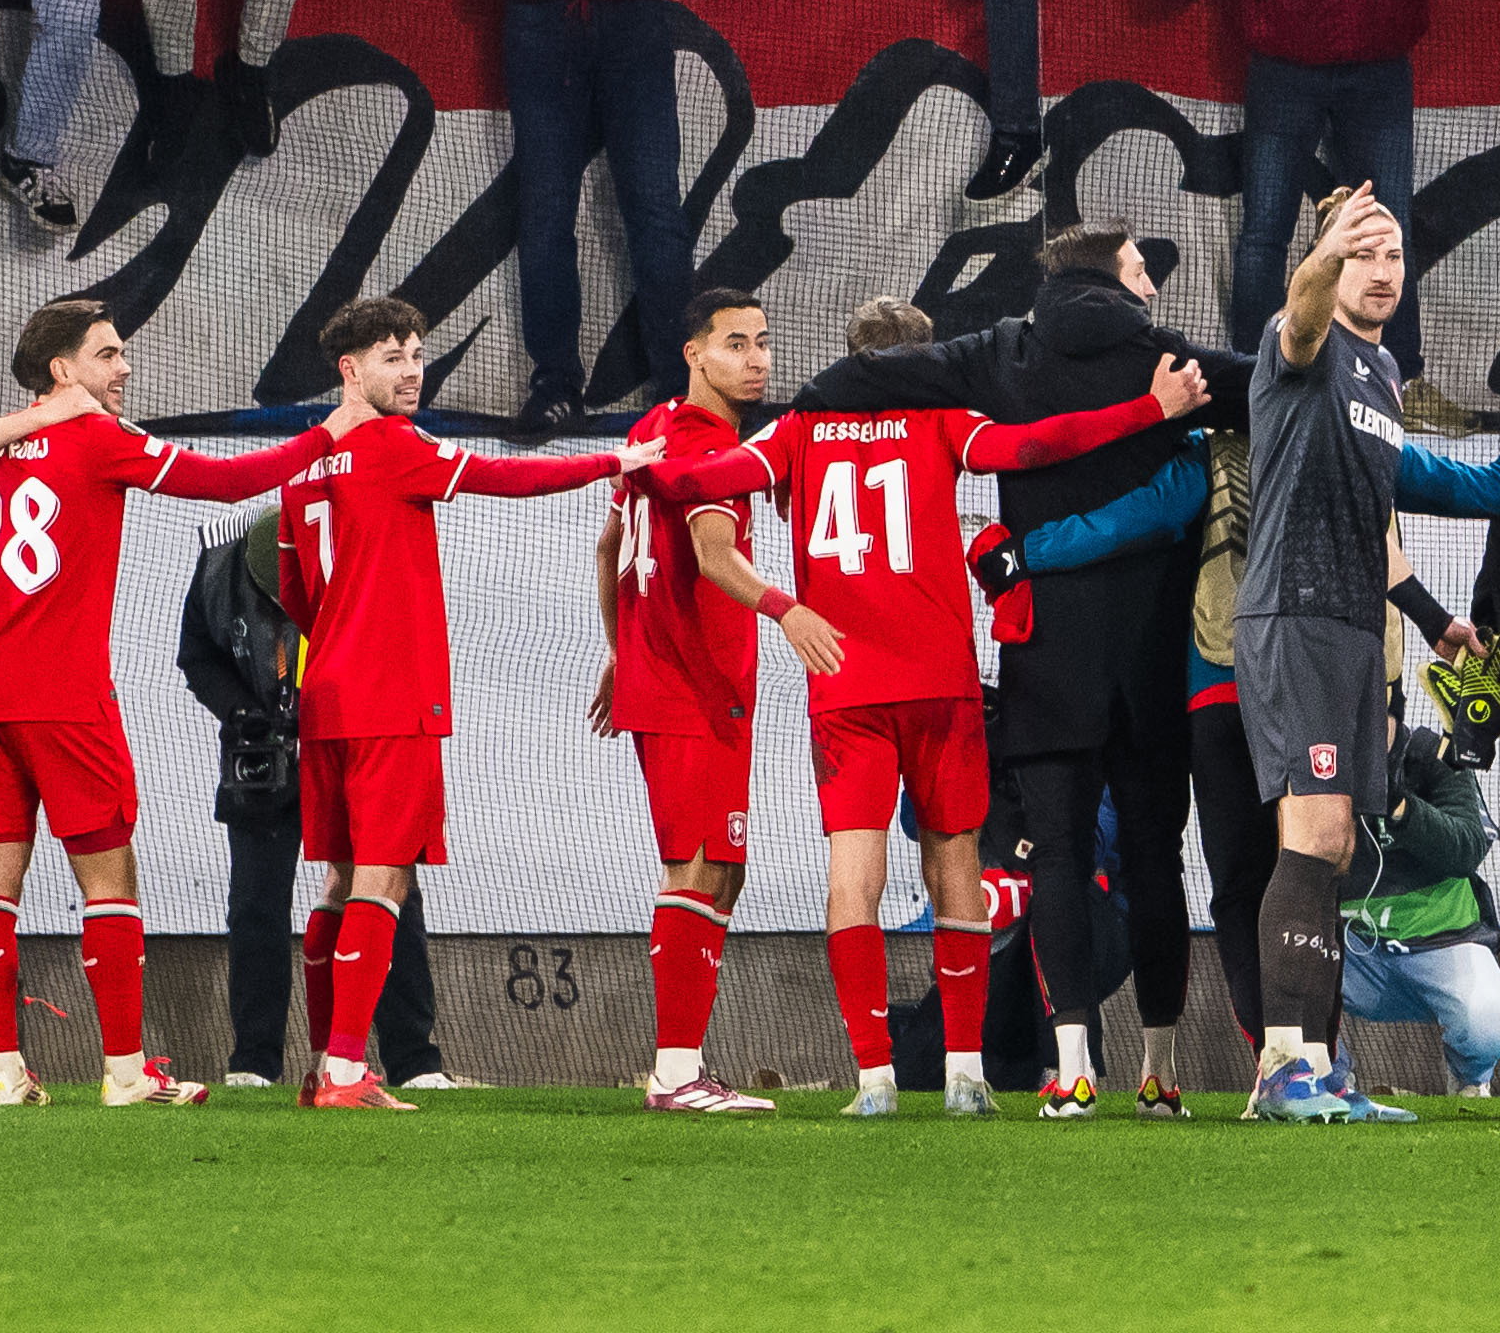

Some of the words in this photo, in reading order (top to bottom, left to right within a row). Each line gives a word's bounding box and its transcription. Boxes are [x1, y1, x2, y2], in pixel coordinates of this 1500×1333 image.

[812, 417, 908, 444] BESSELINK
[807, 457, 914, 576] 41
[506, 943, 580, 1010] 83
